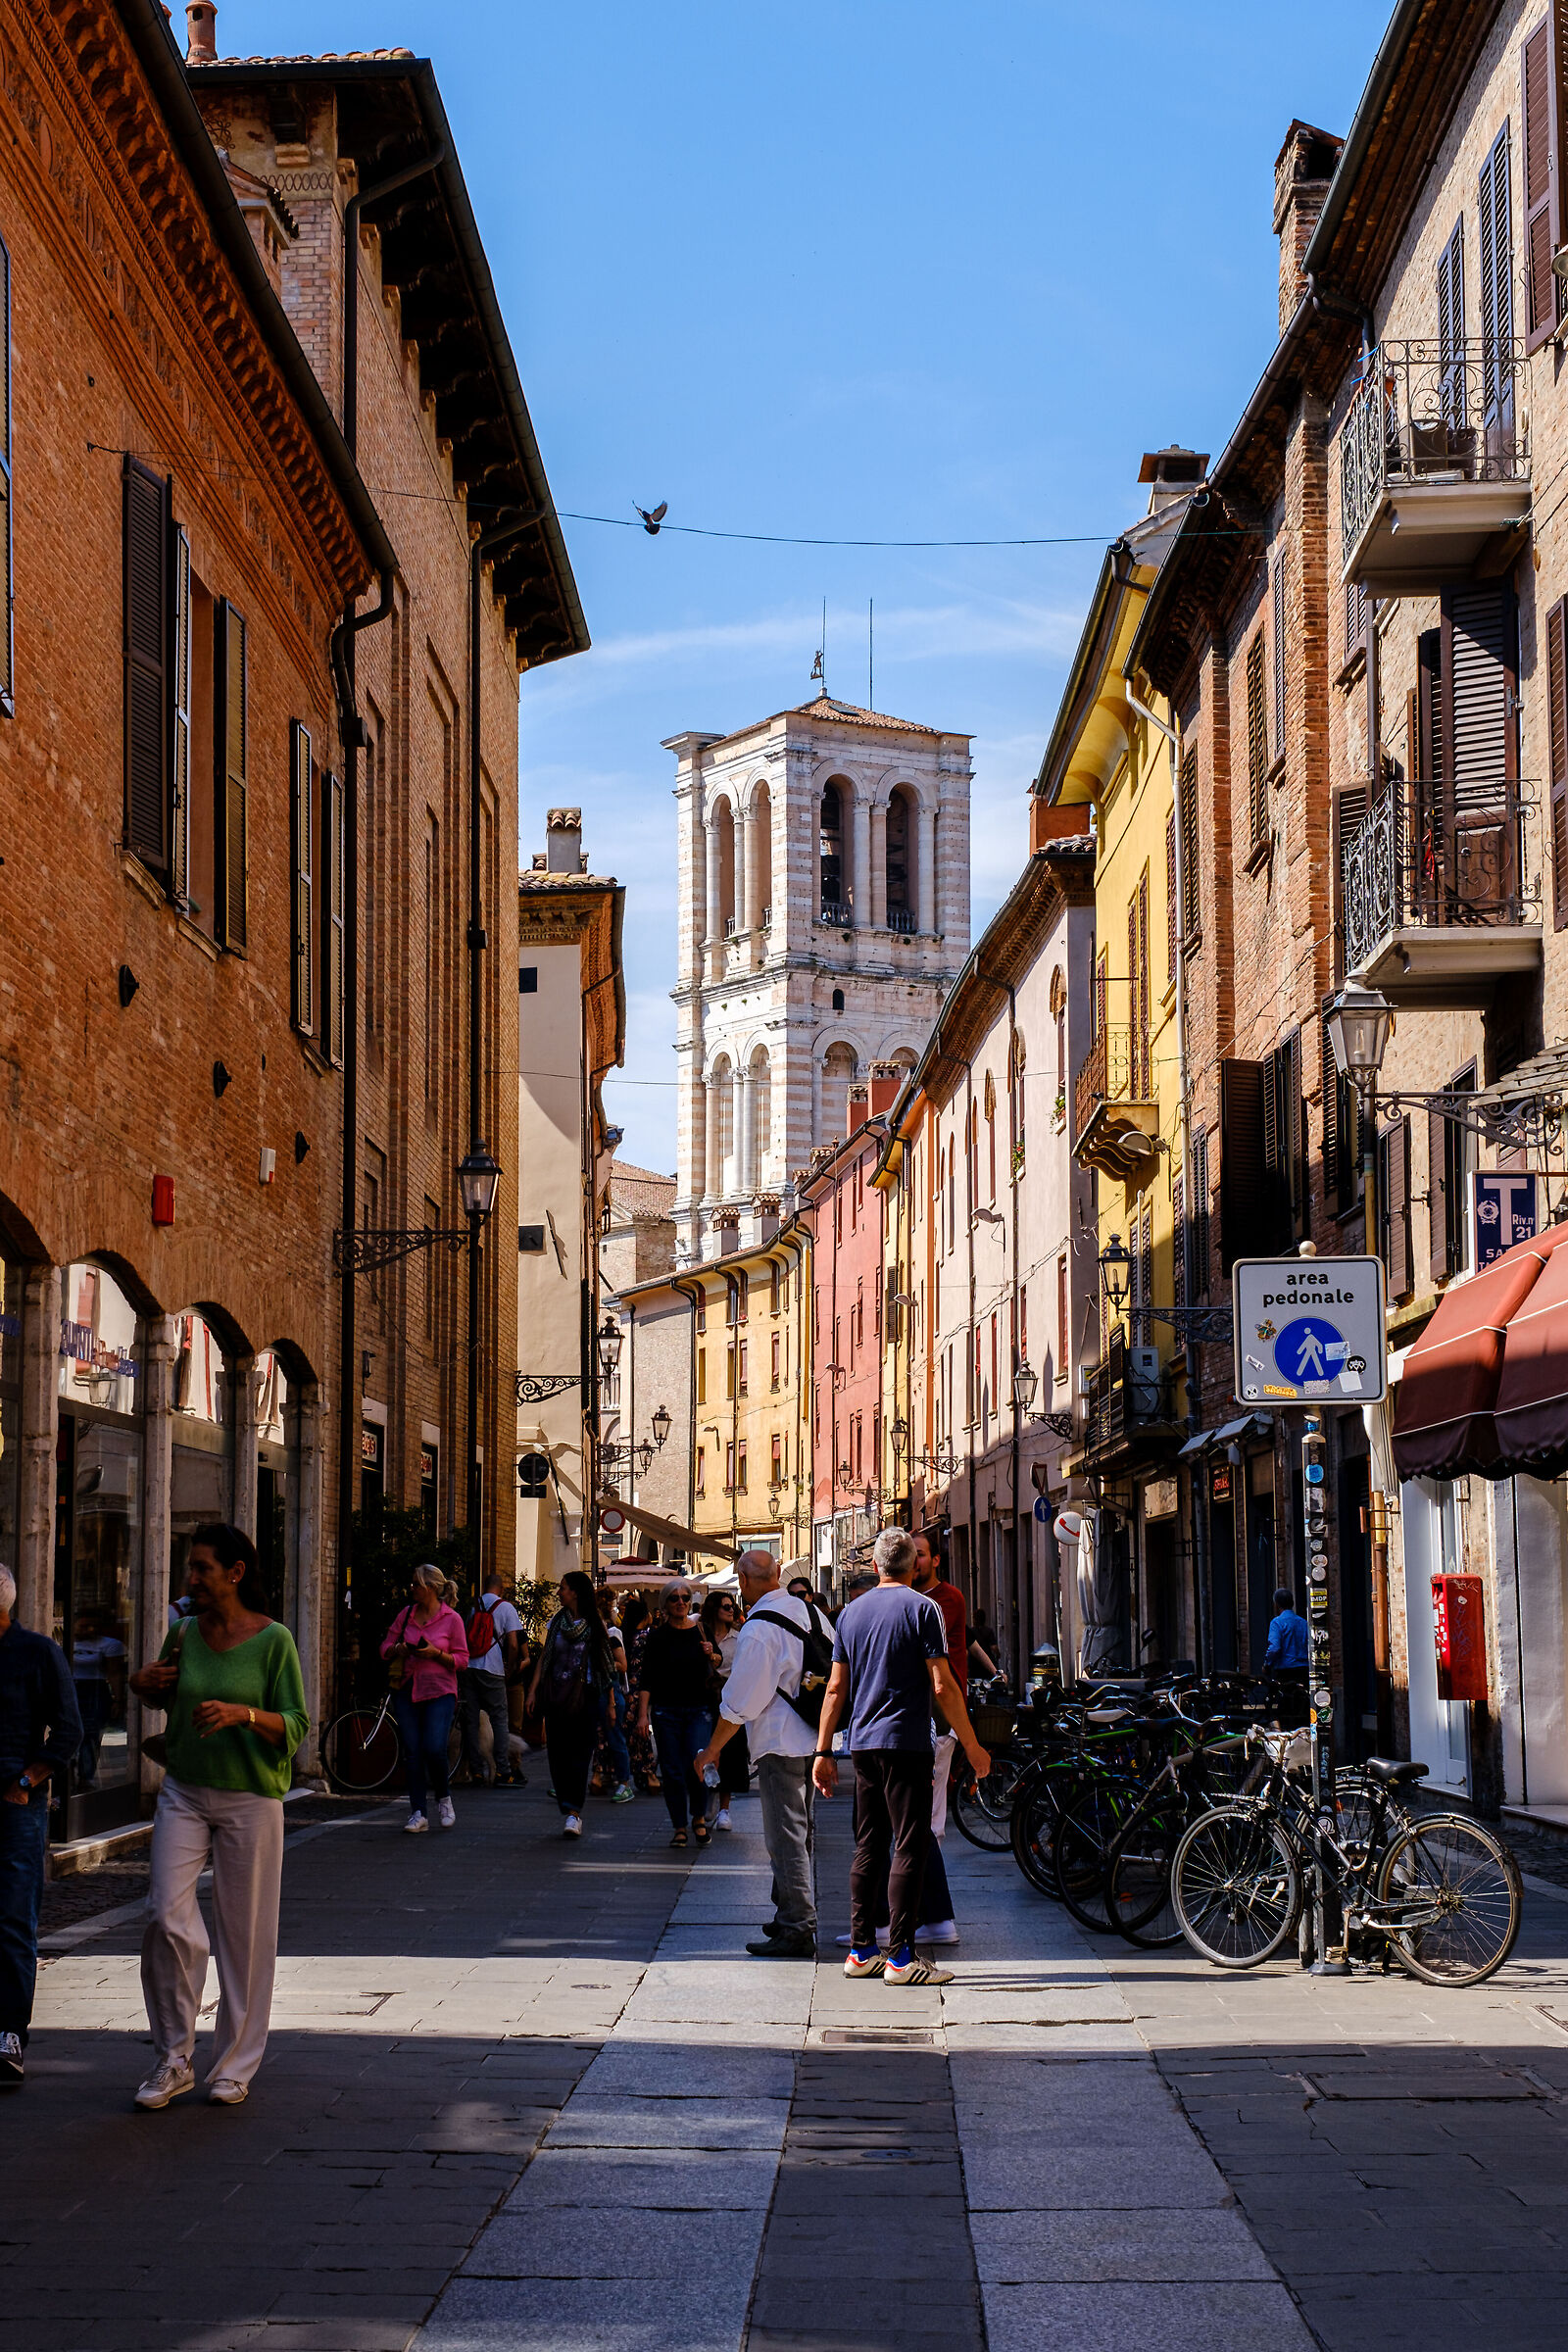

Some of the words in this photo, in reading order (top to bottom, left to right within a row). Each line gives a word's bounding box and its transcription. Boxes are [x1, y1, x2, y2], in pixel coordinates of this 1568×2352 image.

[1483, 1178, 1528, 1246] T
[1515, 1226, 1532, 1239] 21
[1286, 1273, 1329, 1286] area
[1262, 1289, 1354, 1308] pedonale
